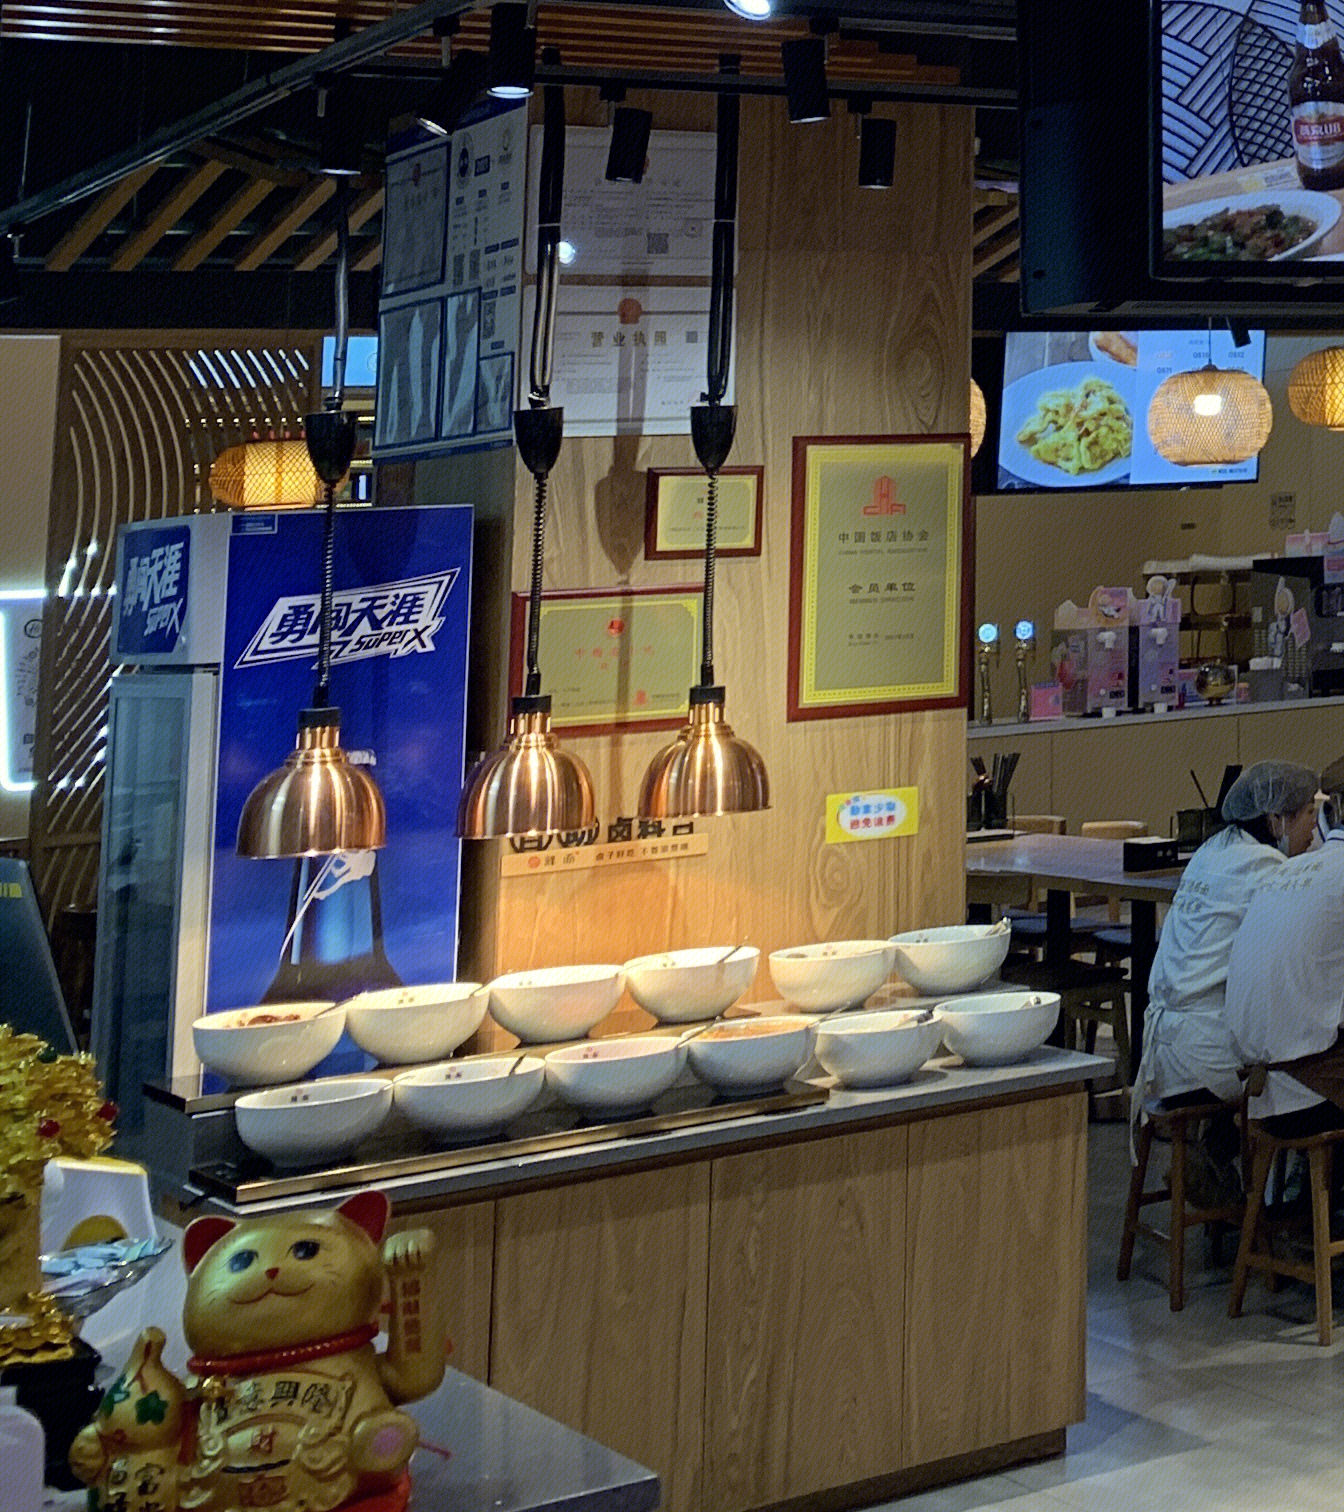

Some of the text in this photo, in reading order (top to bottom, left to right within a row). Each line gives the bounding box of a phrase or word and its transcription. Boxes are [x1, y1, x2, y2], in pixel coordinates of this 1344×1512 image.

[591, 330, 667, 348] 营业执照
[838, 529, 930, 544] 中国饭店协会
[848, 581, 917, 595] 会员单位
